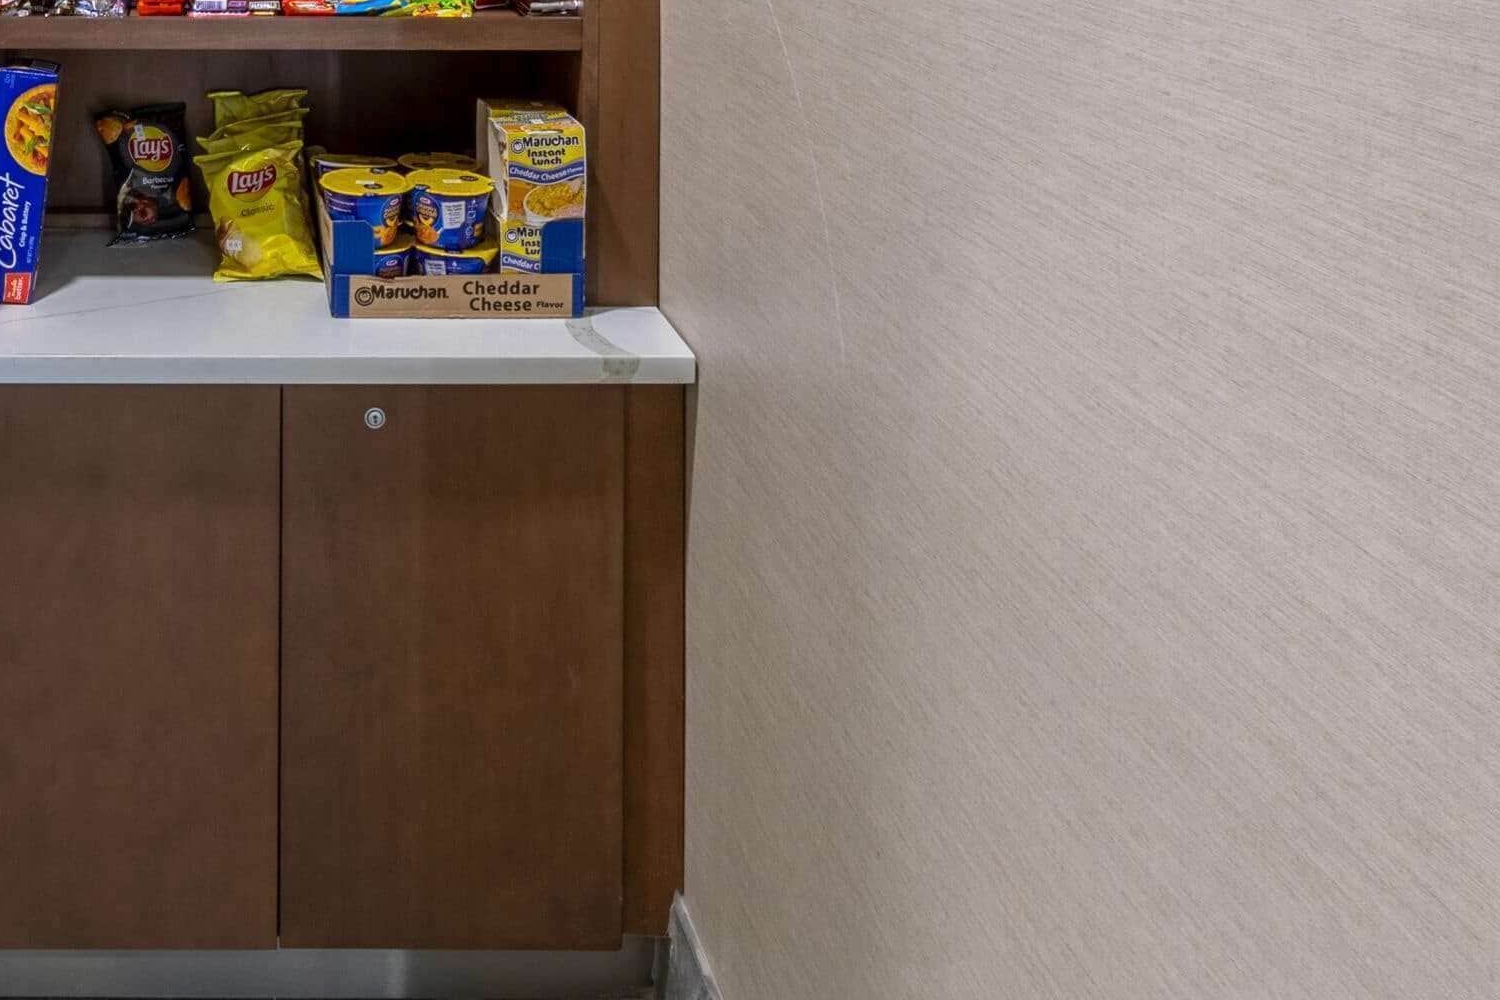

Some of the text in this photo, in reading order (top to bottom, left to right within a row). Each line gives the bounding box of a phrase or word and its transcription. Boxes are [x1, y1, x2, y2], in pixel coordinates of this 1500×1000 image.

[522, 135, 580, 147] Maruchan
[133, 139, 170, 162] Lay's
[527, 148, 566, 158] Instant
[531, 158, 562, 166] Lunch
[231, 166, 274, 194] Lay's
[509, 166, 540, 179] Cheddar
[540, 169, 567, 181] Cheese
[21, 201, 32, 224] Buttery
[18, 231, 27, 248] Crisp
[521, 239, 540, 248] Inst
[502, 255, 533, 269] Cheddar
[462, 280, 541, 296] Cheddar
[470, 297, 564, 312] Cheese Flavor
